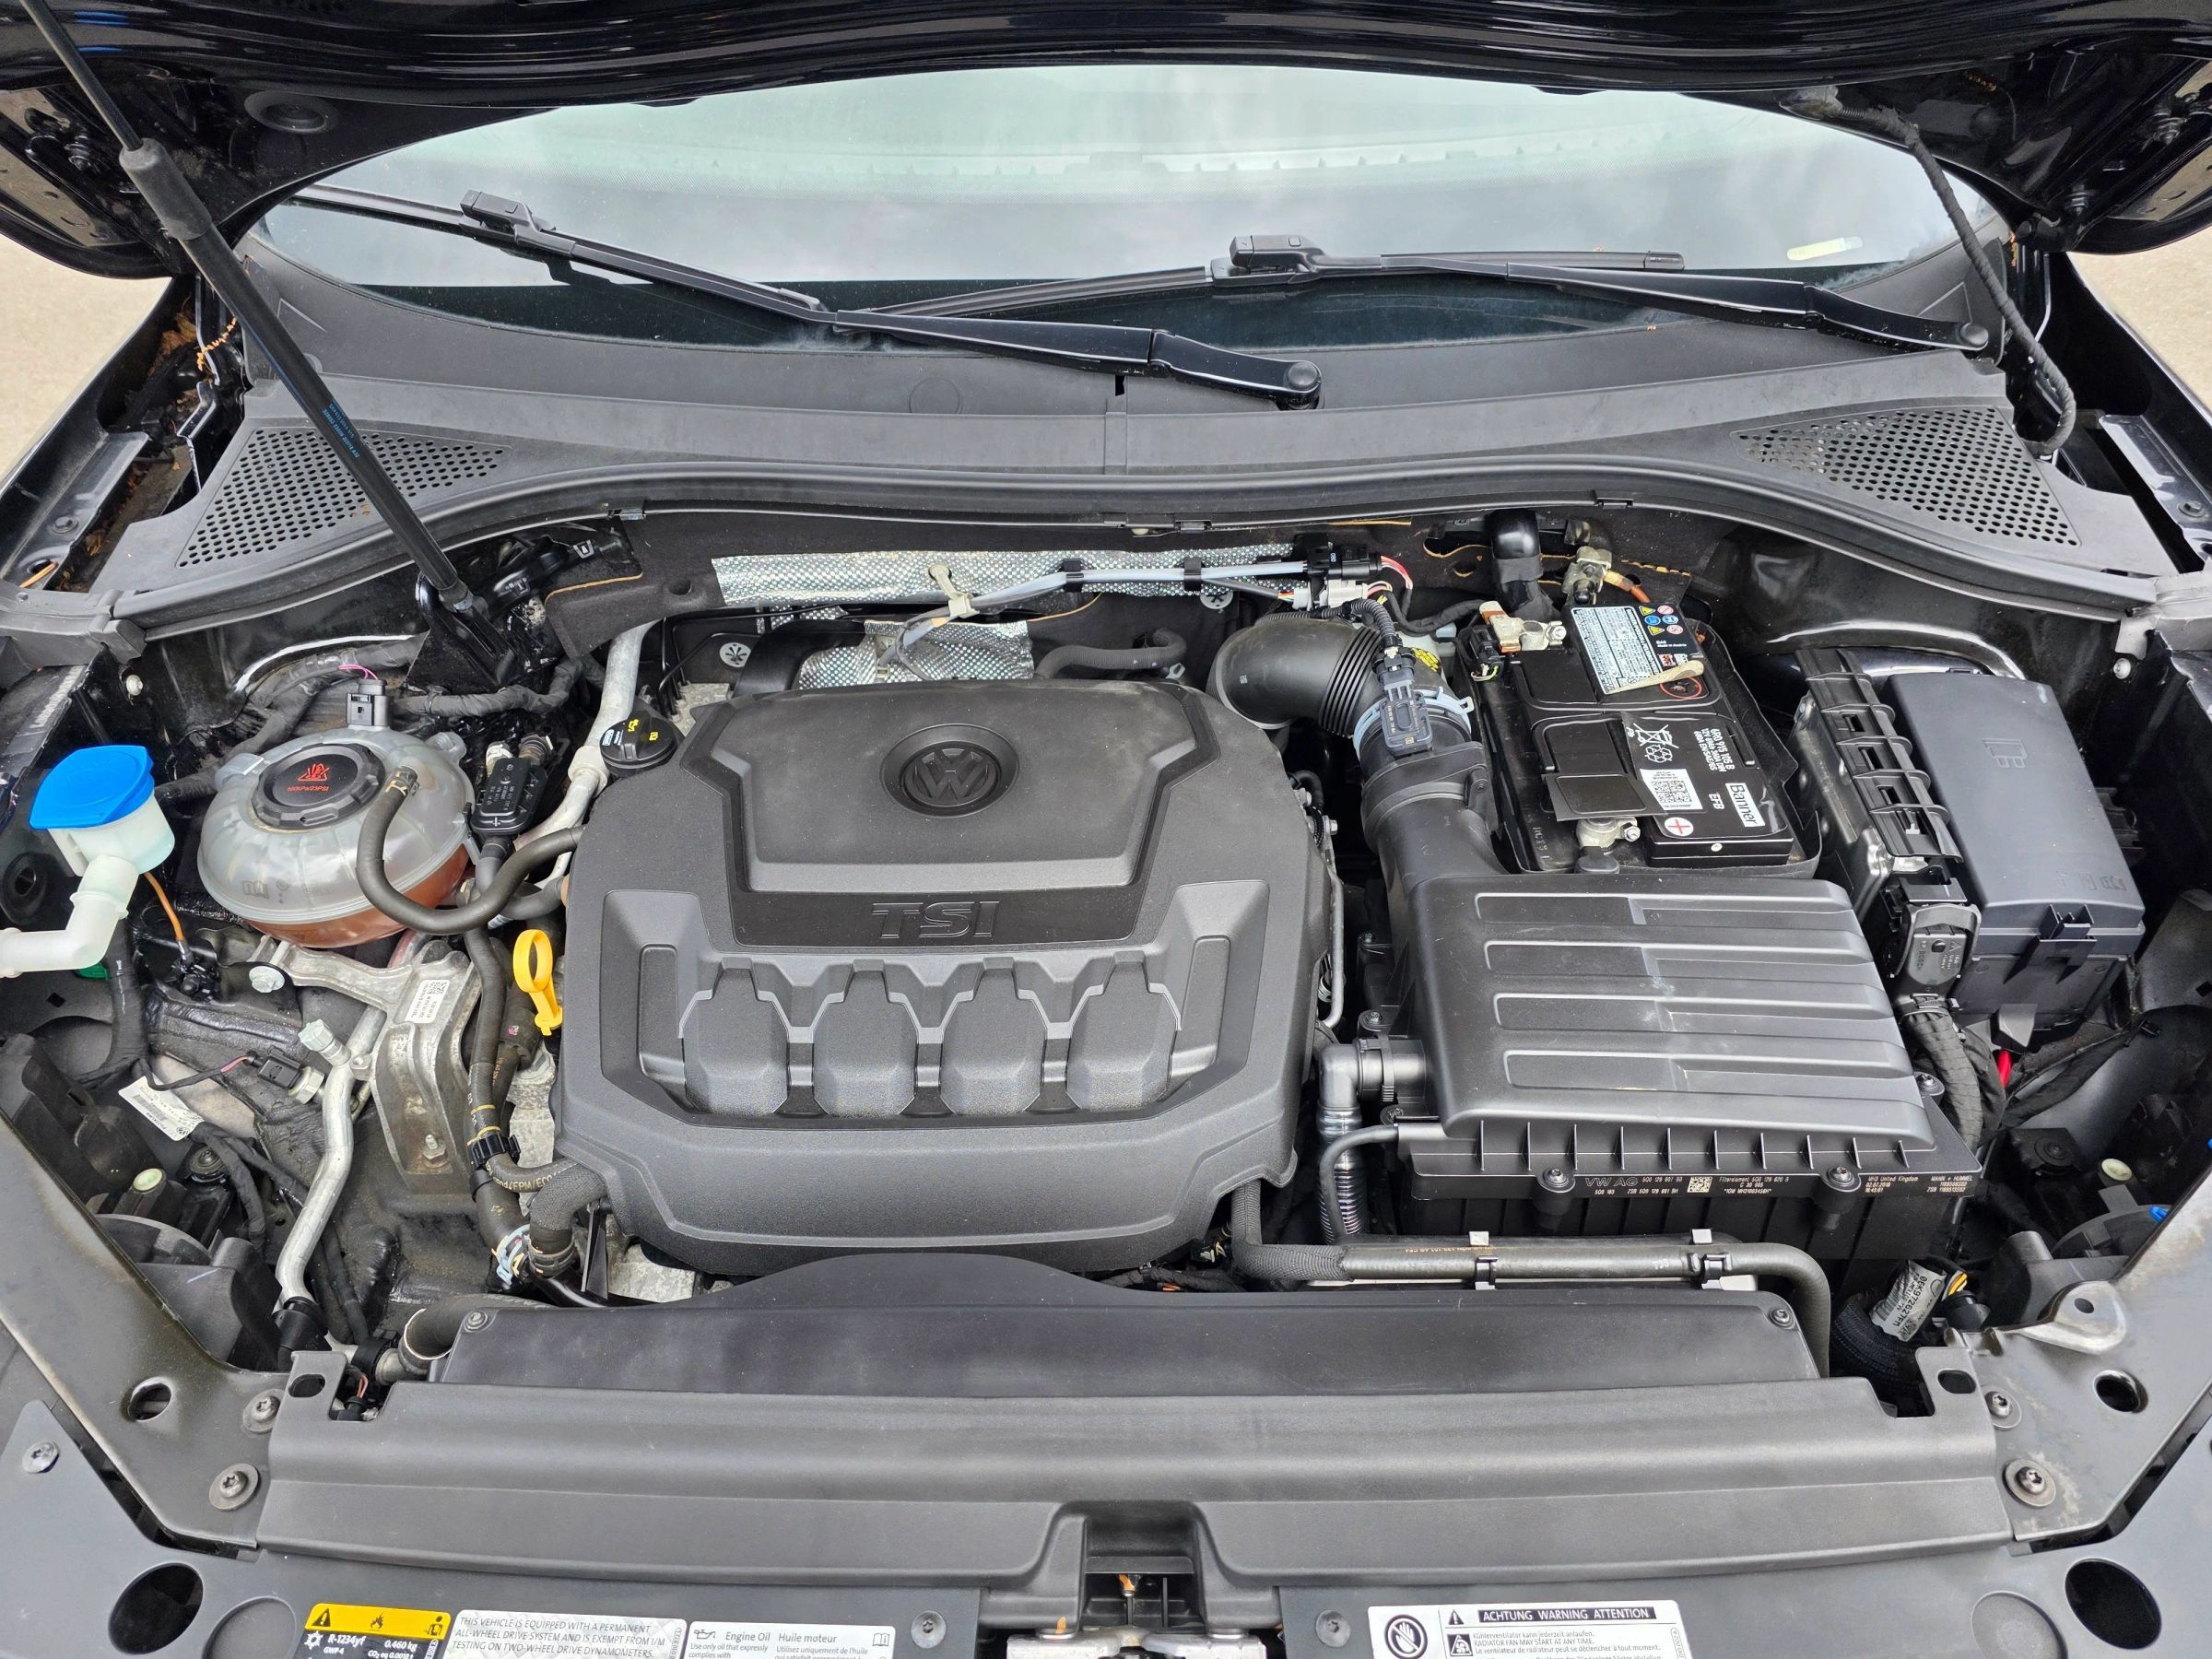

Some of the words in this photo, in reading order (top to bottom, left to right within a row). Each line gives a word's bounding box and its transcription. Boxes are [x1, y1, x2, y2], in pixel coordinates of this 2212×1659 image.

[1715, 741, 1728, 753] 915
[1721, 753, 1733, 764] 105
[1709, 793, 1725, 810] EFB
[1730, 785, 1757, 824] Banner
[872, 901, 1000, 939] TSI
[1585, 1177, 1611, 1186] VW
[1614, 1177, 1638, 1186] AG
[1483, 1611, 1533, 1621] ACHTUNG
[1538, 1609, 1588, 1620] WARNING
[1594, 1608, 1649, 1619] ATTENTION
[461, 1618, 478, 1626] THIS
[481, 1618, 514, 1627] VEHICLE
[525, 1620, 566, 1630] EQUIPPED
[568, 1622, 590, 1630] WITH
[600, 1624, 651, 1633] PERMANENT
[328, 1634, 366, 1648] R-1234yf
[455, 1630, 501, 1638] ALL-WHEEL
[503, 1631, 528, 1640] DRIVE
[529, 1632, 560, 1641] SYSTEM
[561, 1634, 581, 1642] AND
[592, 1635, 624, 1644] EXEMPT
[625, 1636, 649, 1645] FROM
[725, 1632, 756, 1643] Engine
[758, 1632, 771, 1641] Oil
[778, 1633, 802, 1642] Huile
[804, 1634, 837, 1643] moteur
[384, 1640, 406, 1650] 0.460
[406, 1642, 418, 1652] kg
[453, 1641, 486, 1650] TESTING
[488, 1642, 502, 1651] ON
[504, 1643, 555, 1653] TWO-WHEEL
[557, 1645, 582, 1654] DRIVE
[584, 1646, 654, 1658] DYNAMOMETERS.
[800, 1646, 839, 1655] uniquement
[1555, 1646, 1569, 1654] peut
